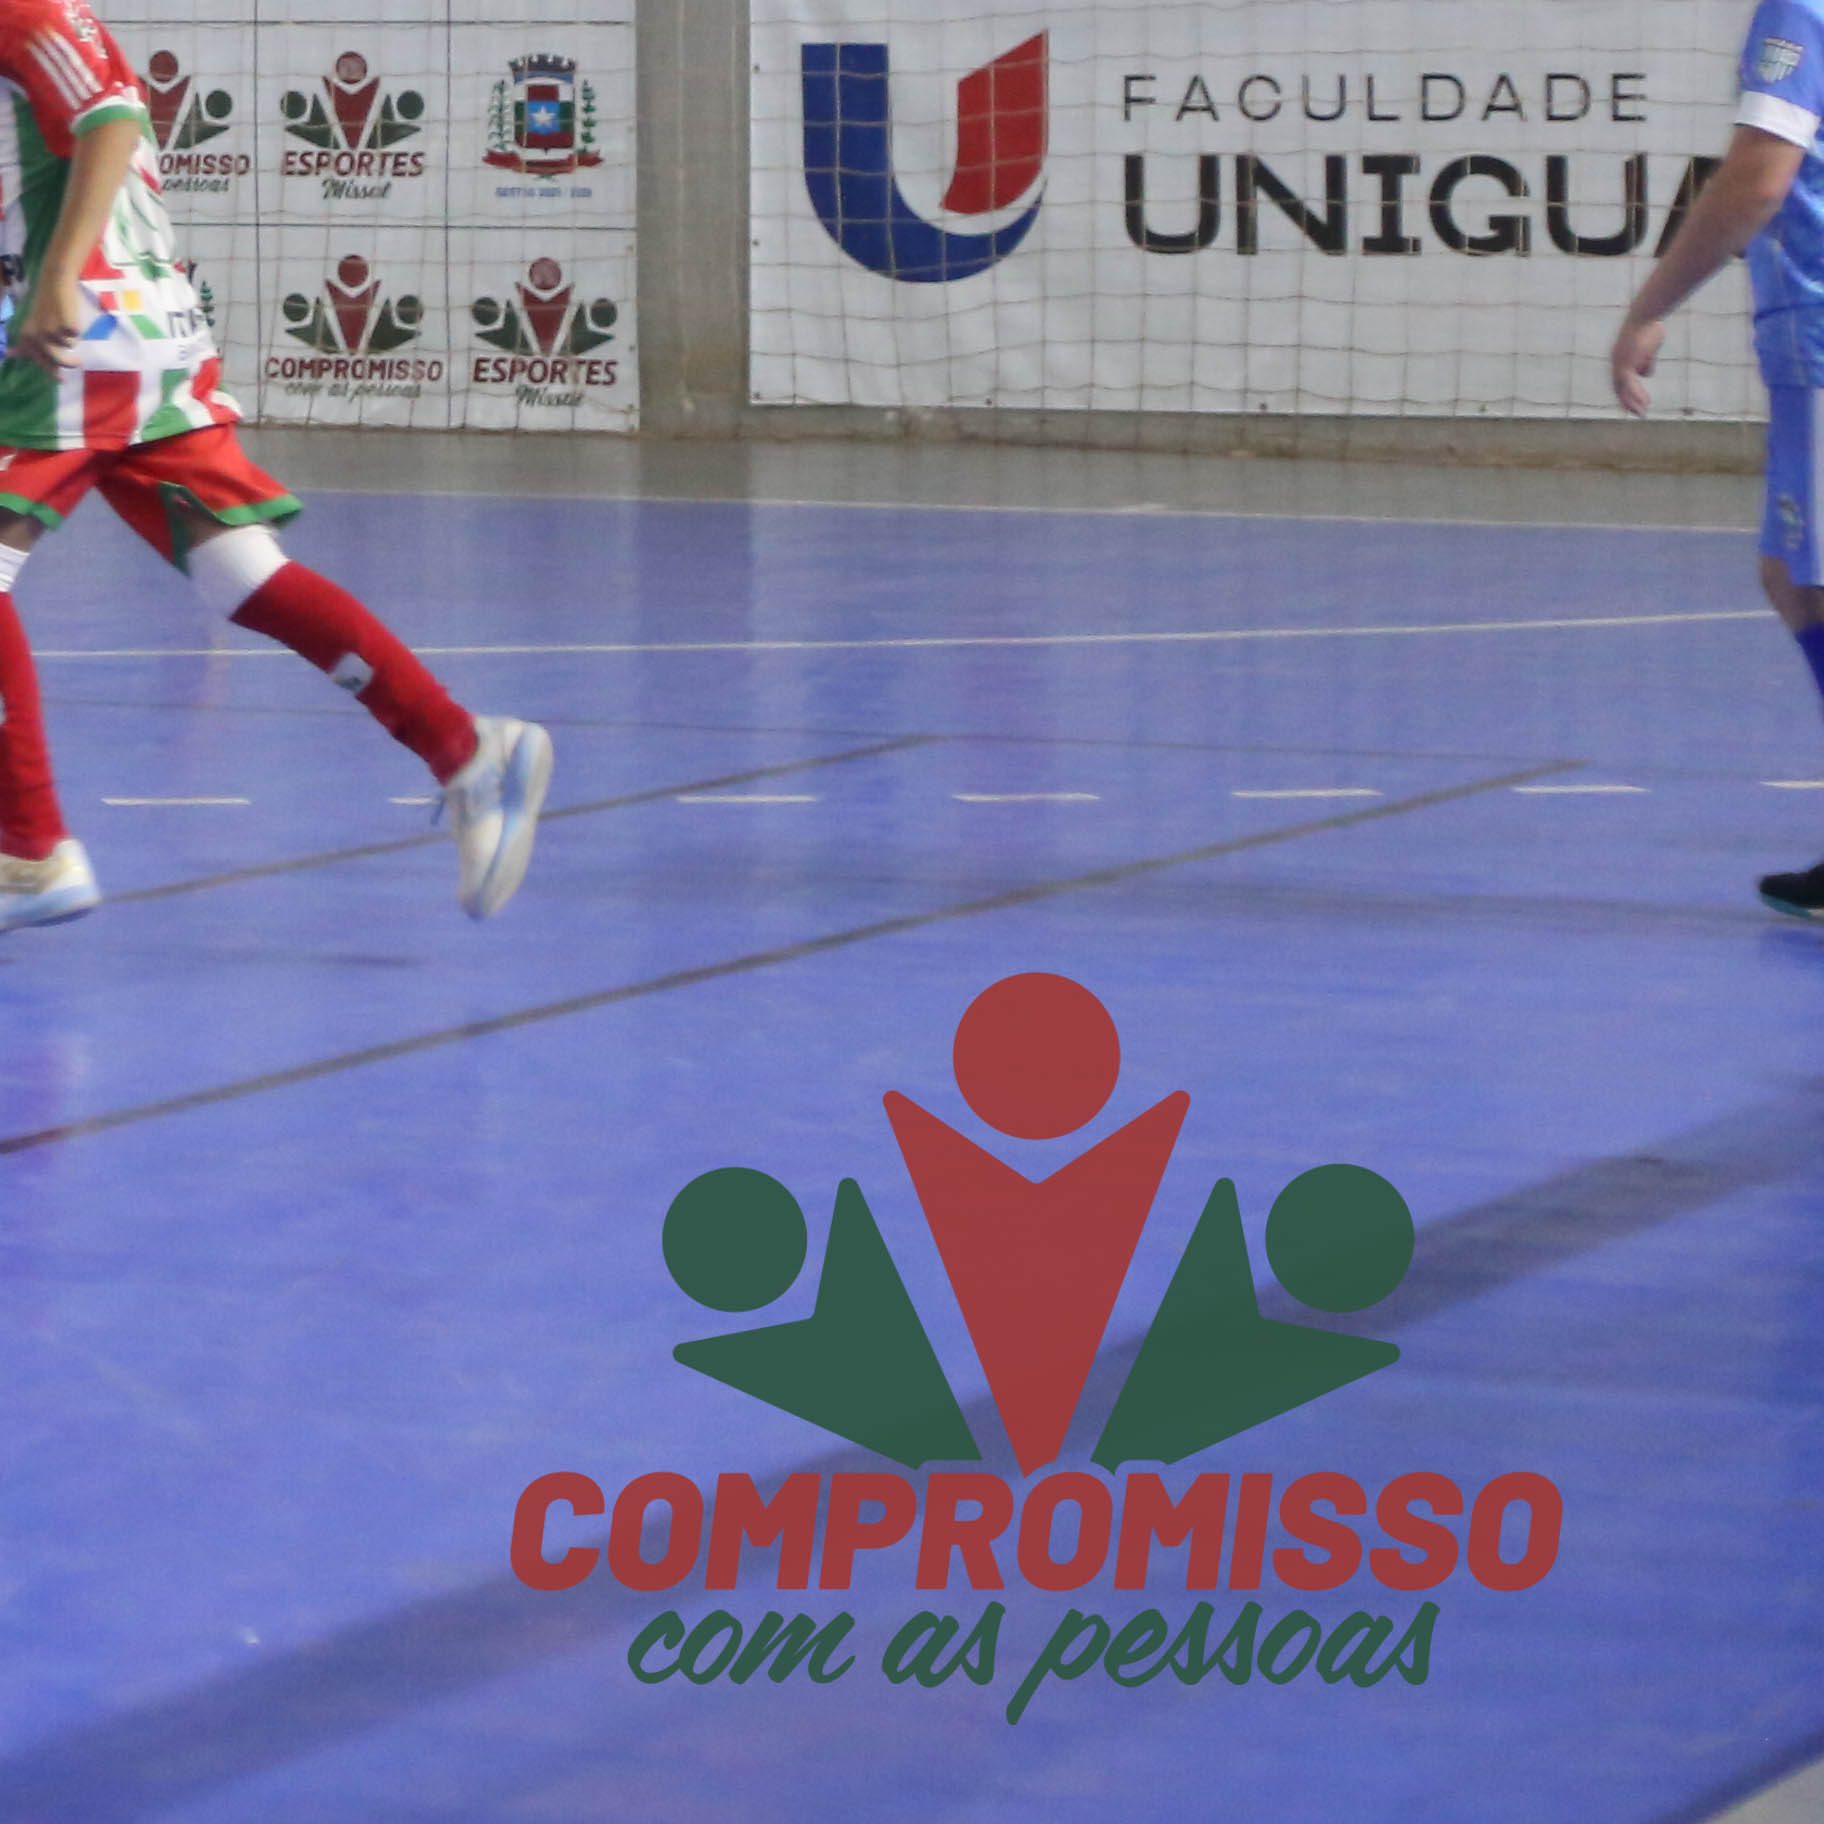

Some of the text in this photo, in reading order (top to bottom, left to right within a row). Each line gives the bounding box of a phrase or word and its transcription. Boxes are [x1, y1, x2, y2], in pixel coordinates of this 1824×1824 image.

[1122, 73, 1648, 123] FACULDADE
[158, 151, 251, 176] OMISSO
[282, 150, 425, 177] ESPORTES
[264, 357, 444, 382] COMPROMISSO
[472, 357, 618, 385] ESPORTES
